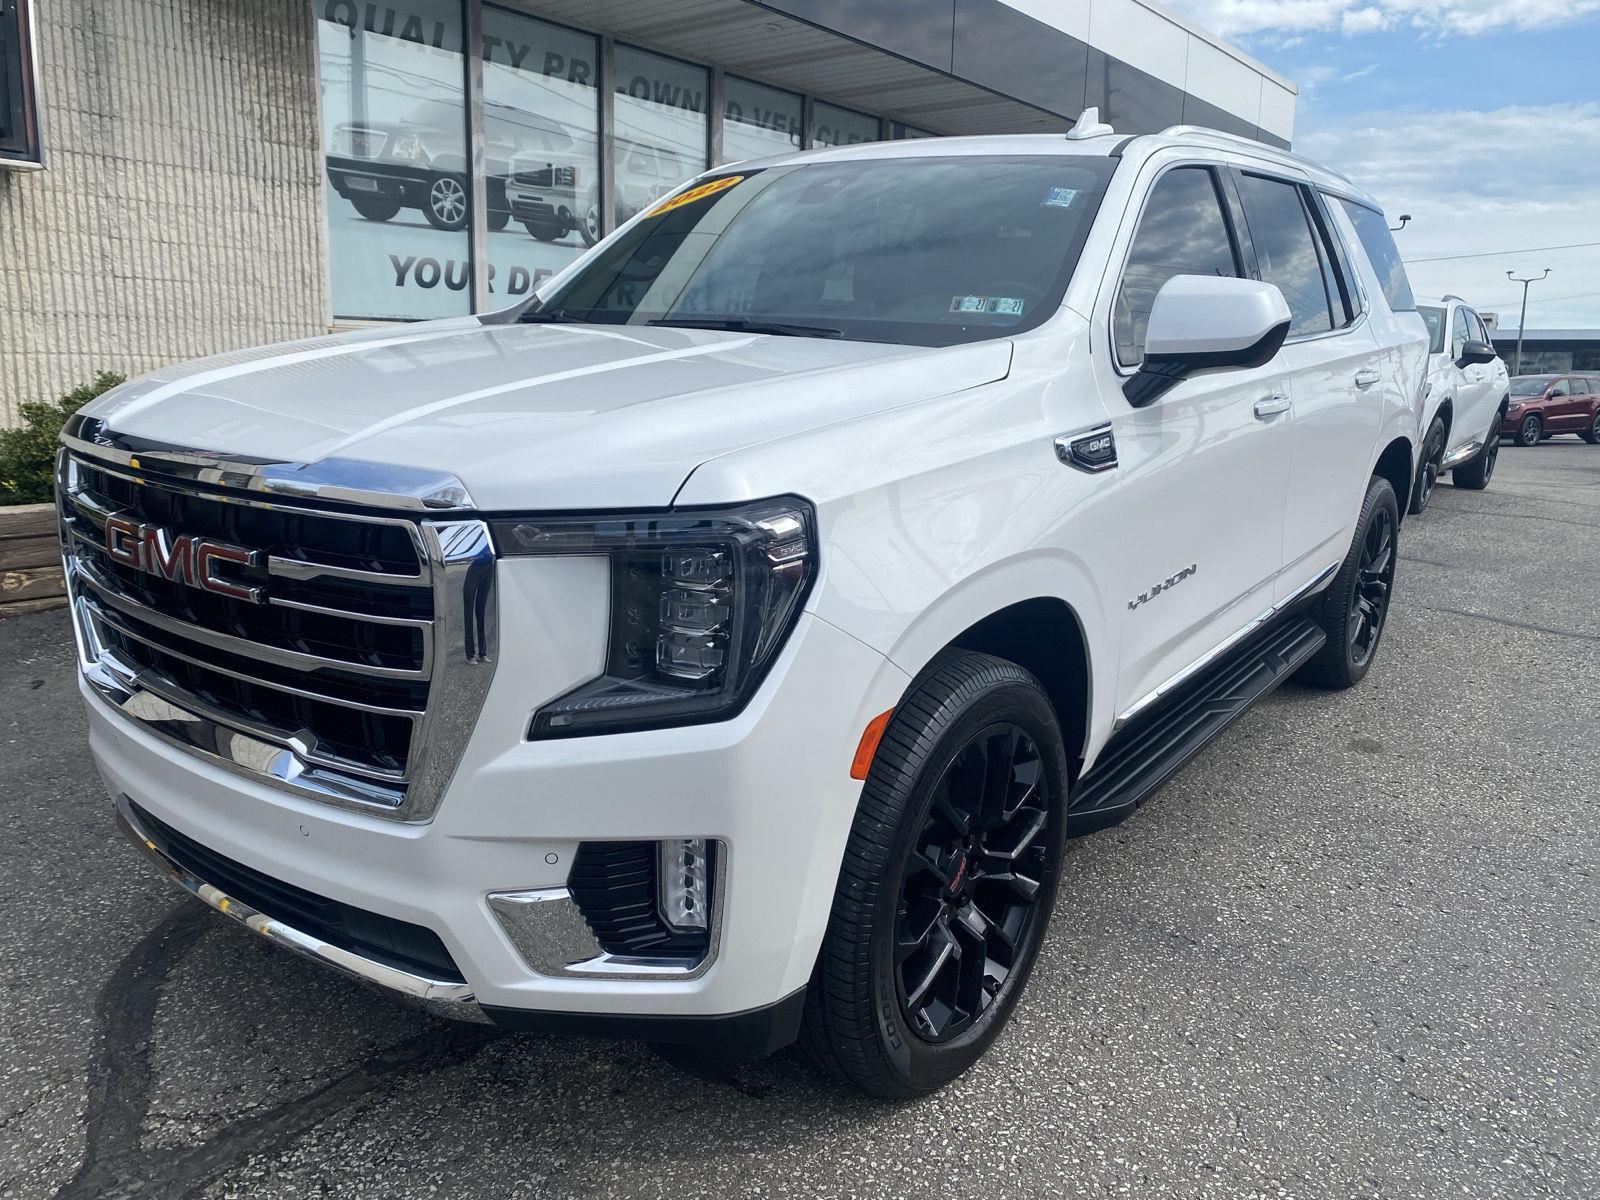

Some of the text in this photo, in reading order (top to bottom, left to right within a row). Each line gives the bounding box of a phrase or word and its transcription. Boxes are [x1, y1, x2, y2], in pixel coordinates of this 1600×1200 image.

[324, 0, 530, 72] QUALTY
[541, 51, 743, 122] PR-OWND
[1089, 437, 1111, 452] GMC
[105, 517, 264, 605] GMC
[1127, 563, 1197, 611] YUKON
